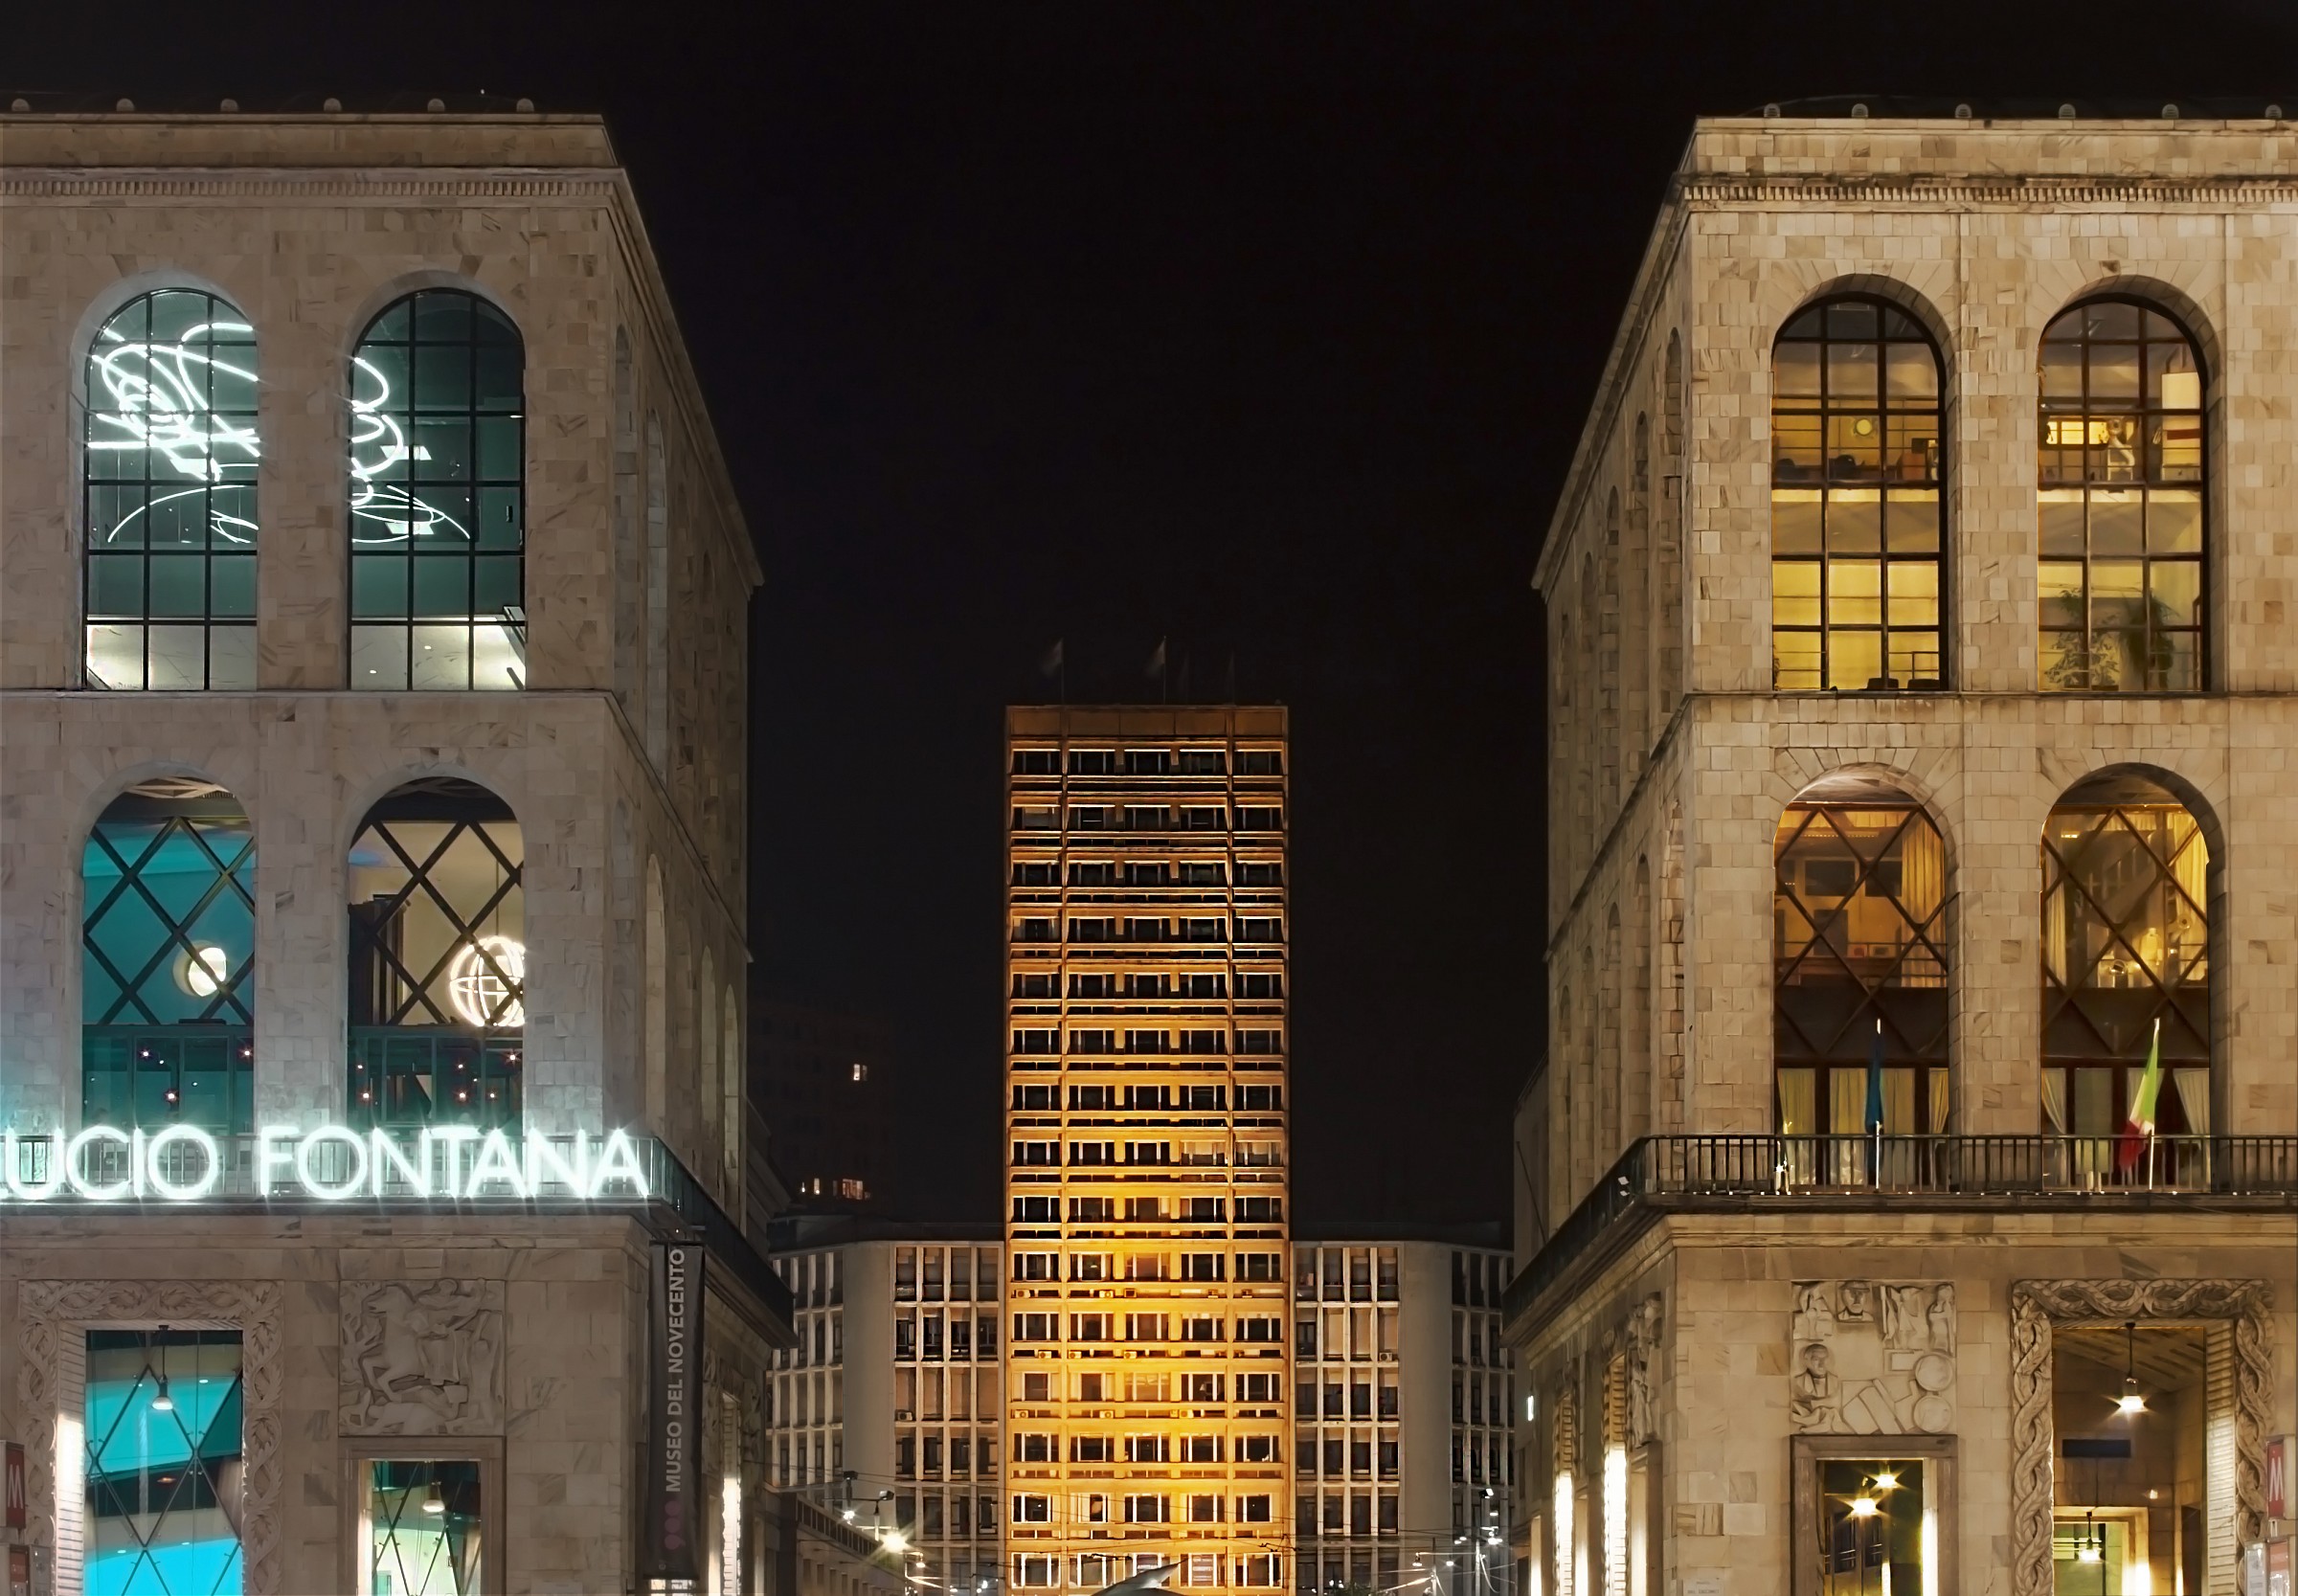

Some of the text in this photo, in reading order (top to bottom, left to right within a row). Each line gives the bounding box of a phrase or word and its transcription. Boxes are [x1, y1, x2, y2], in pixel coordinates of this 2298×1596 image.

[0, 1124, 651, 1201] UCIO FONTANA
[665, 1248, 686, 1493] MUSEO DEL NOVECENTO
[7, 1464, 24, 1510] M
[2269, 1456, 2285, 1502] M
